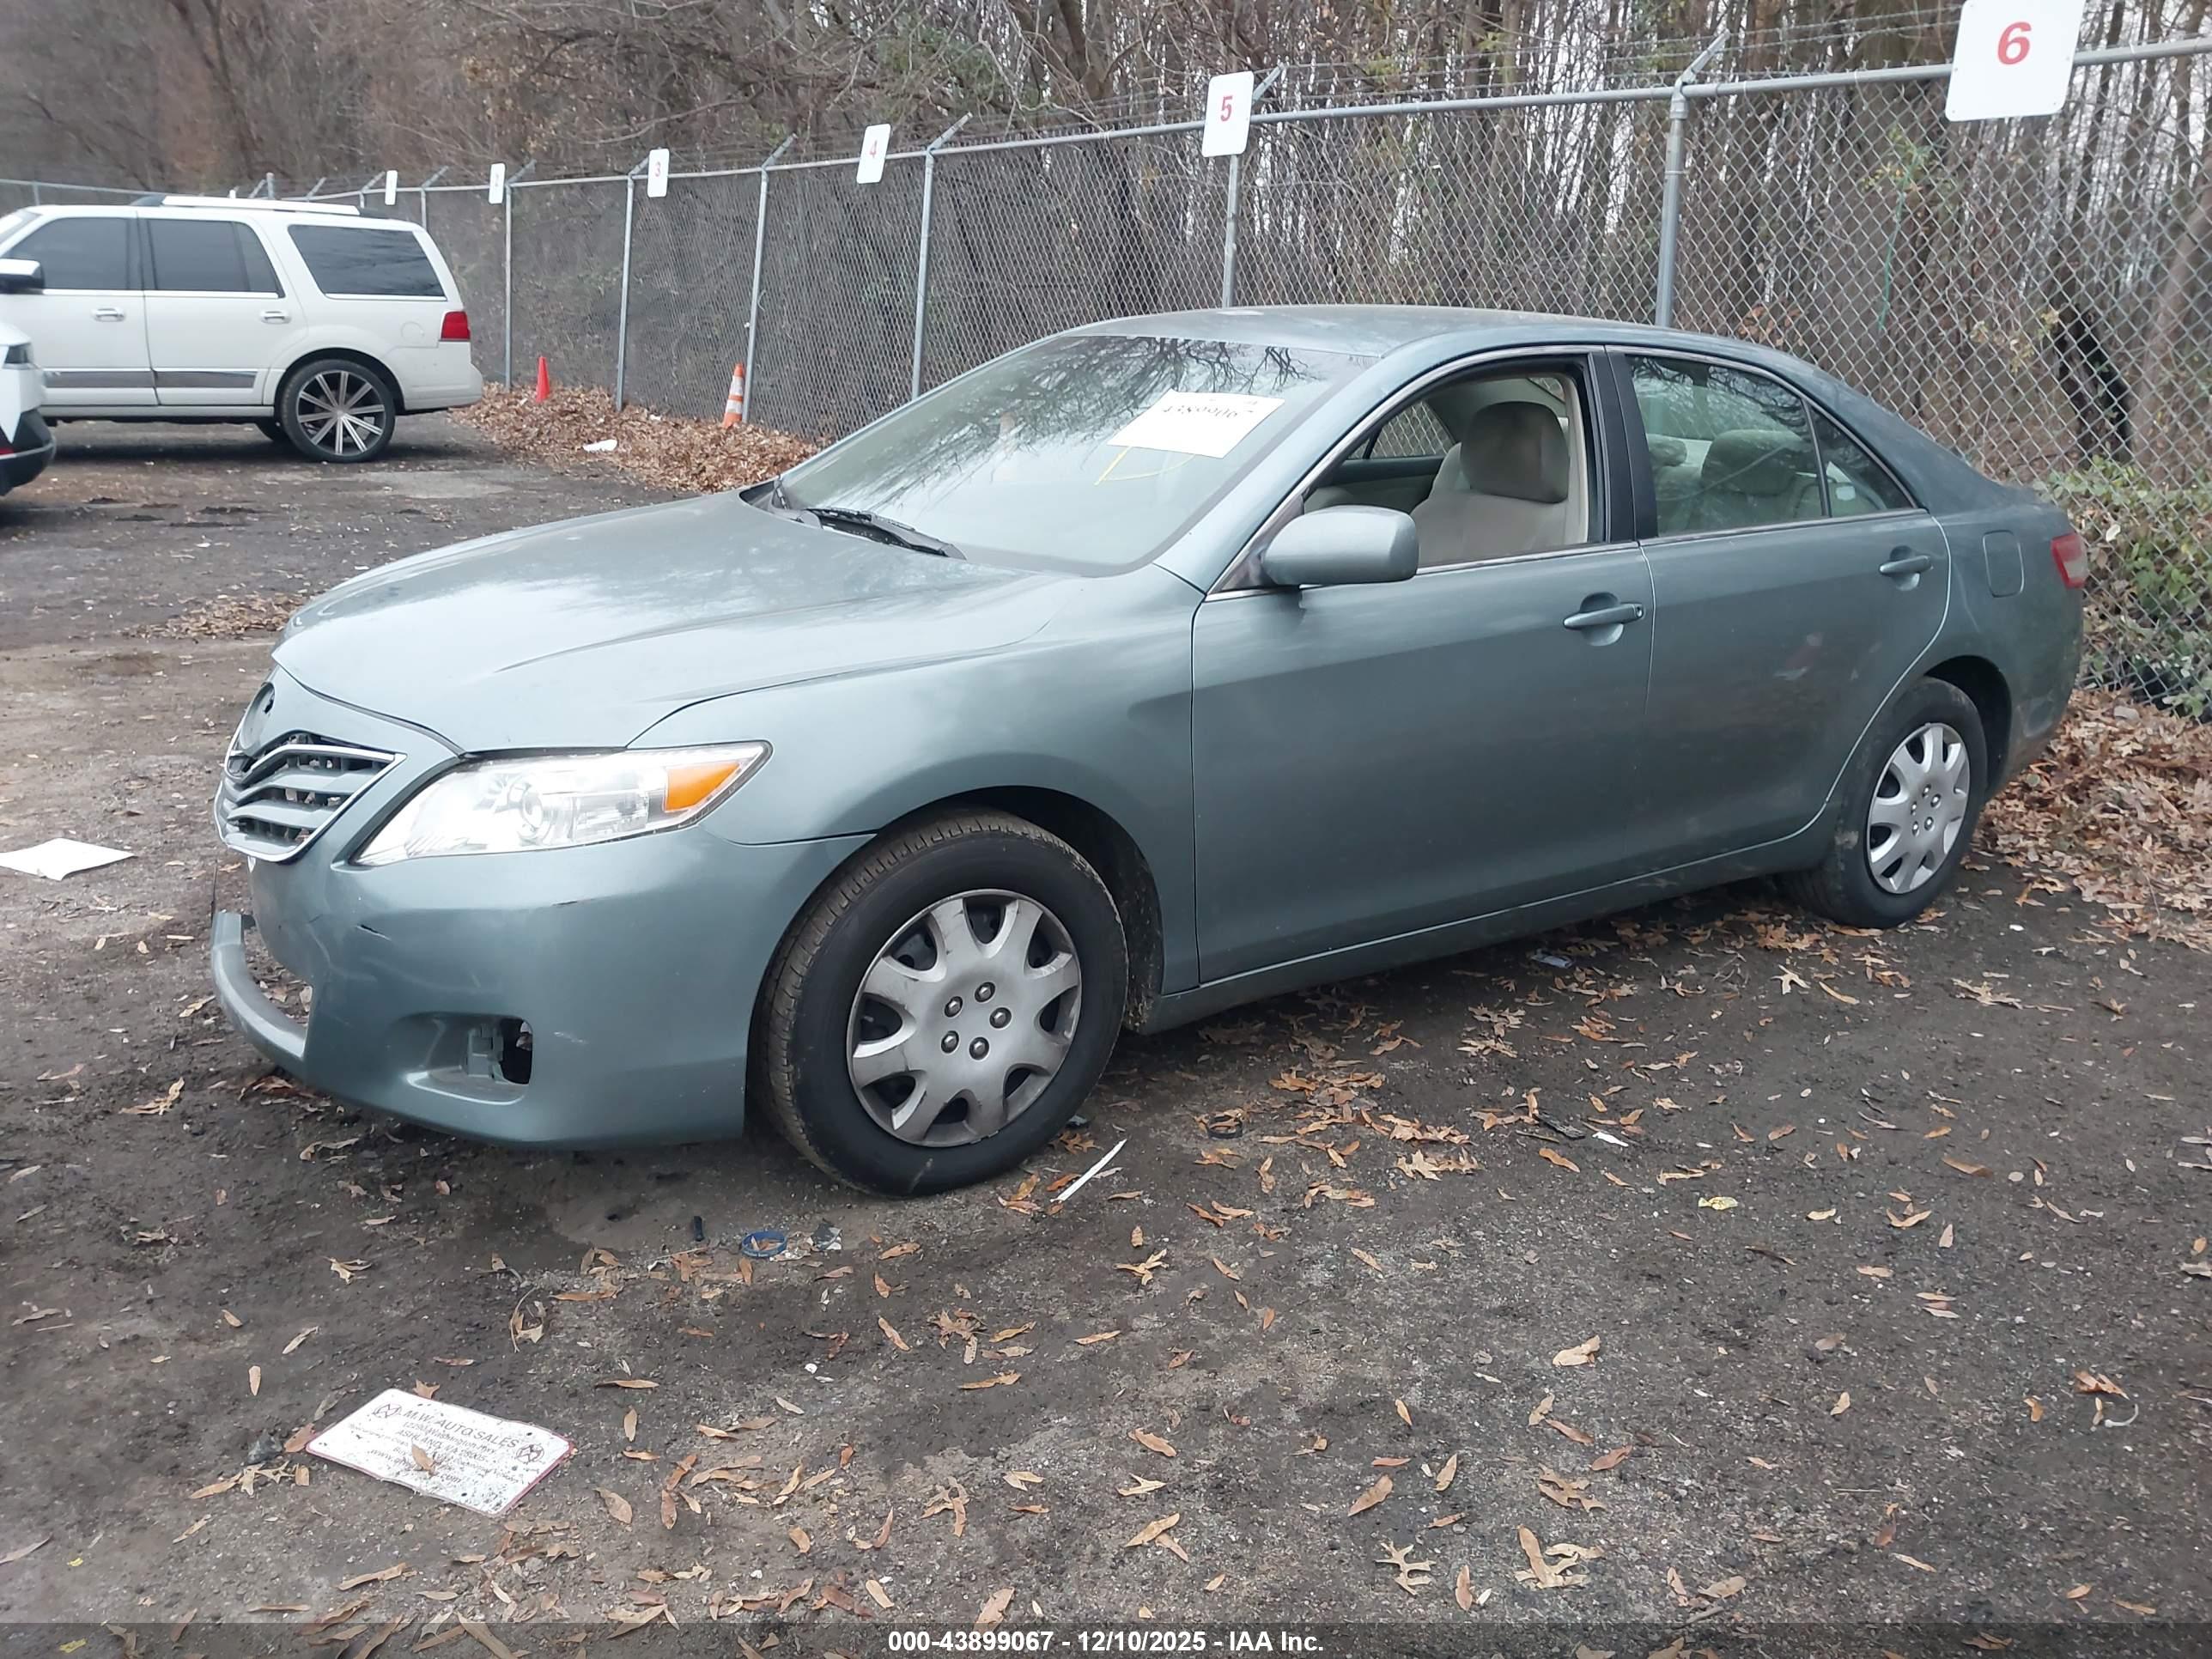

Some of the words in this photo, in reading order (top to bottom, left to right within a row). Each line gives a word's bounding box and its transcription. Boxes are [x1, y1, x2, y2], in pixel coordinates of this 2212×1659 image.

[1997, 21, 2032, 65] 6
[1220, 94, 1233, 122] 5
[869, 140, 878, 159] 4
[433, 1419, 474, 1437] AUTO
[473, 1430, 520, 1449] SALES
